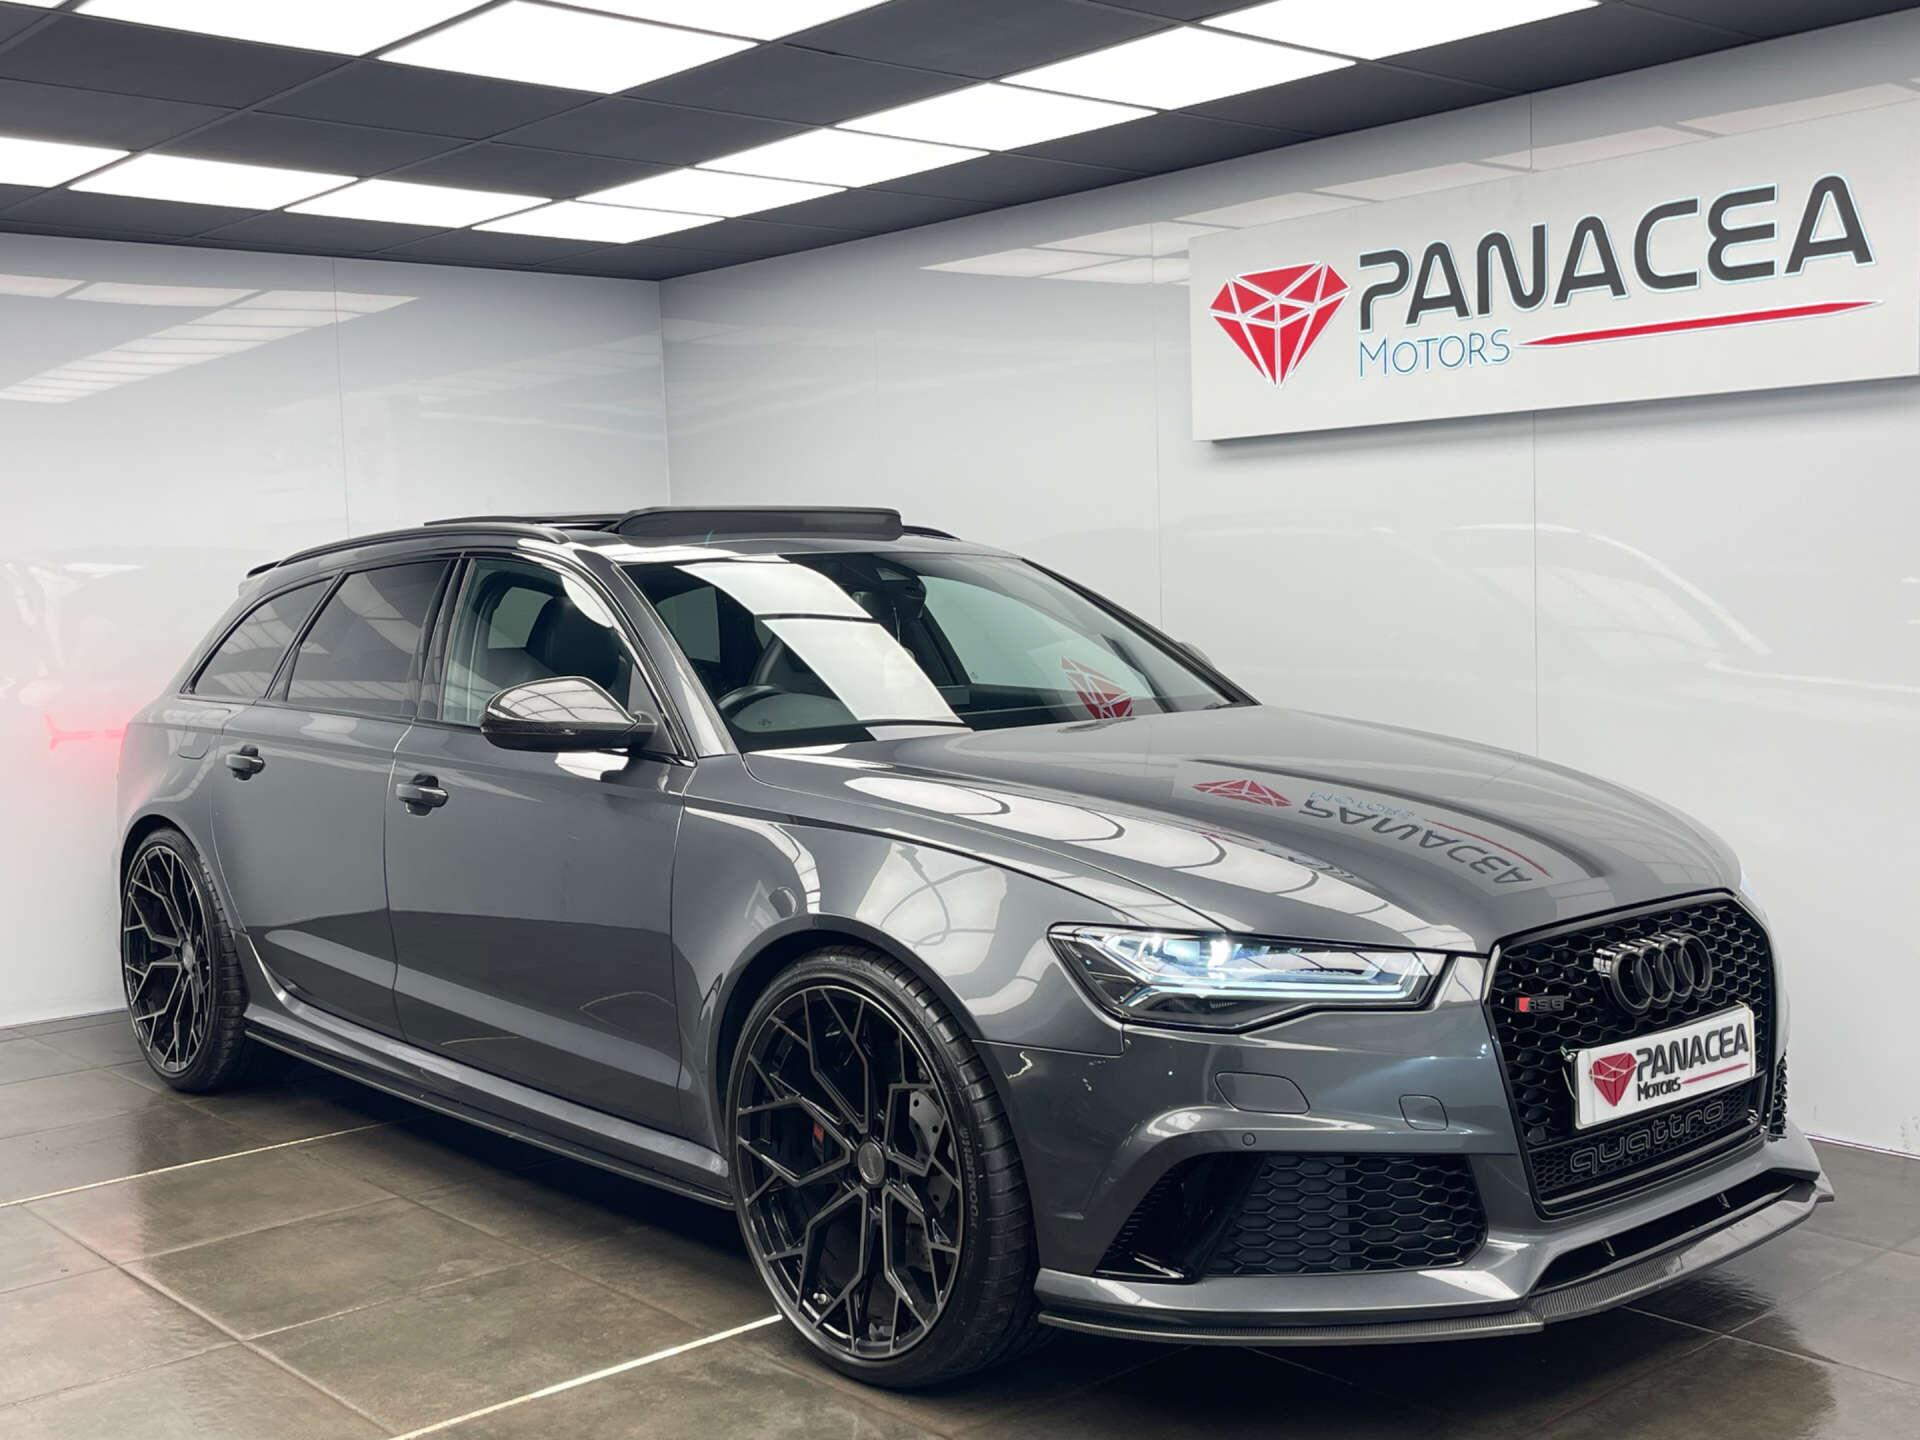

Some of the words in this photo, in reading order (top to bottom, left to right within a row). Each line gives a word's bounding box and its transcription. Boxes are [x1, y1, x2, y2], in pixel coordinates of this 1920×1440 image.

[1358, 173, 1875, 332] PANACEA
[1359, 328, 1511, 379] MOTORS
[1636, 1023, 1750, 1082] PANACEA
[1637, 1077, 1682, 1102] MOTORS
[1570, 1099, 1724, 1175] quattro
